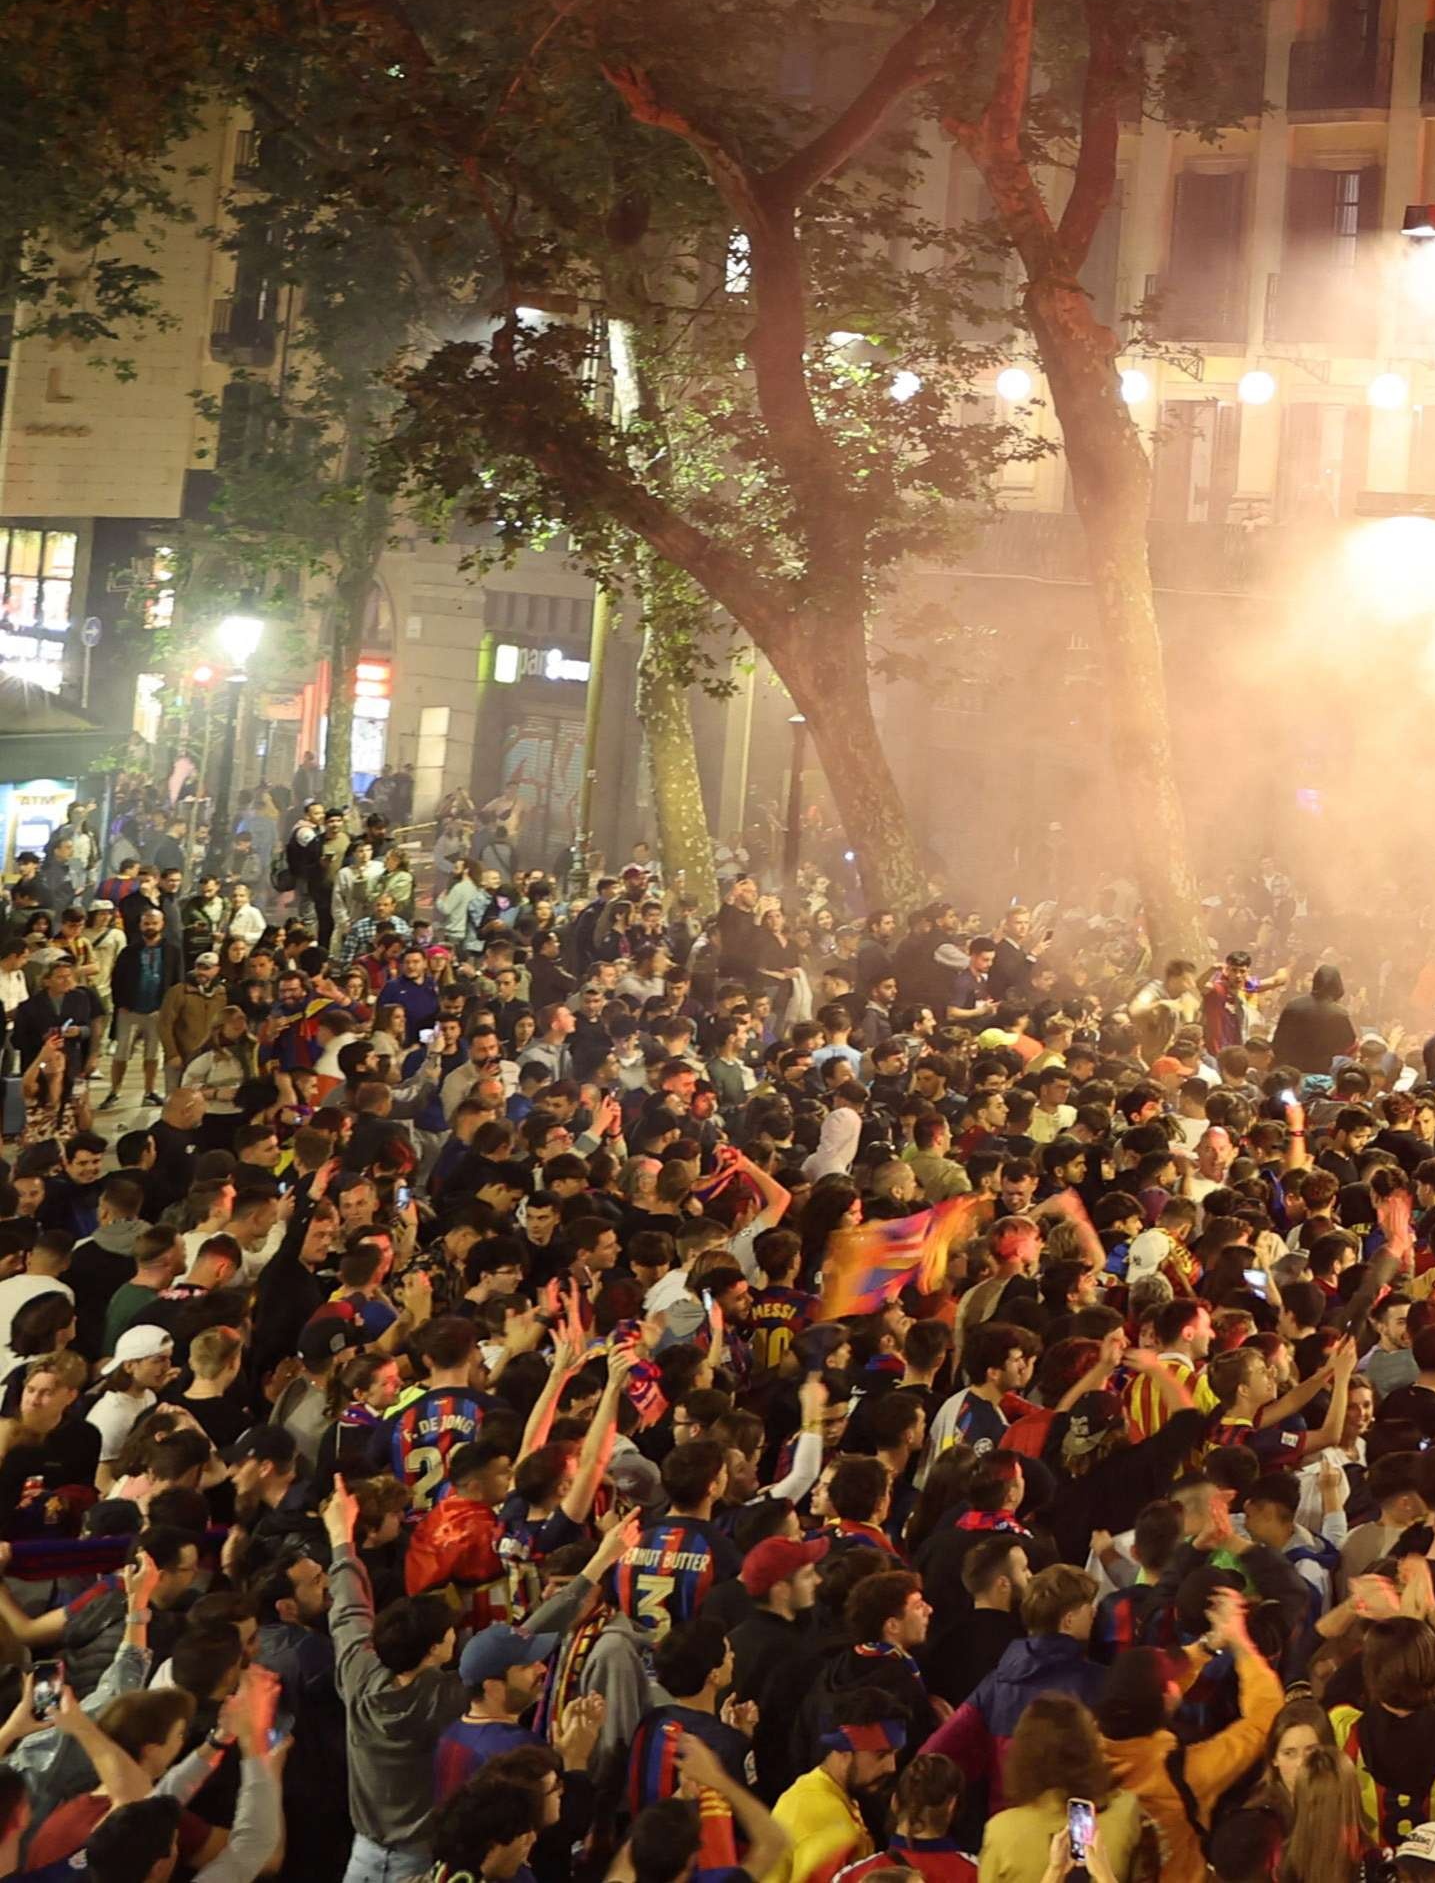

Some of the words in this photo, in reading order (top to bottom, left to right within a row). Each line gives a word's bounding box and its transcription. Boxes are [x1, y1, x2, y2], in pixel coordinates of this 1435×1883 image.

[418, 1416, 439, 1435] DE
[439, 1414, 474, 1435] JONG
[662, 1551, 711, 1572] BUTTER
[636, 1573, 676, 1643] 3
